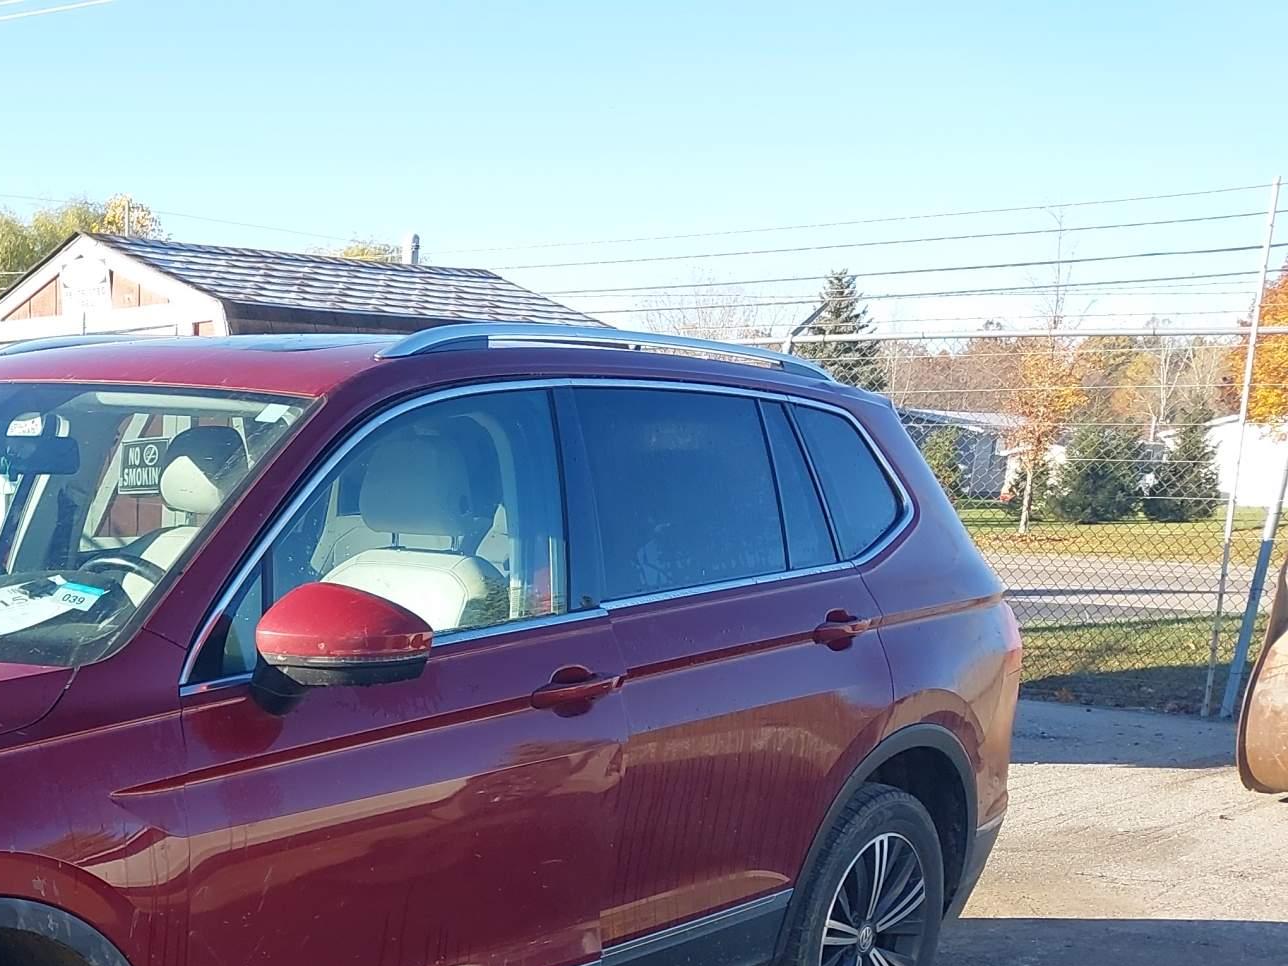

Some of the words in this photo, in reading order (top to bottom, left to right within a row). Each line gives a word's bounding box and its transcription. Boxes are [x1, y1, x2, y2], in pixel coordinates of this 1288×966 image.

[128, 447, 141, 466] NO
[123, 466, 161, 487] SMOKIN
[62, 593, 85, 605] 039
